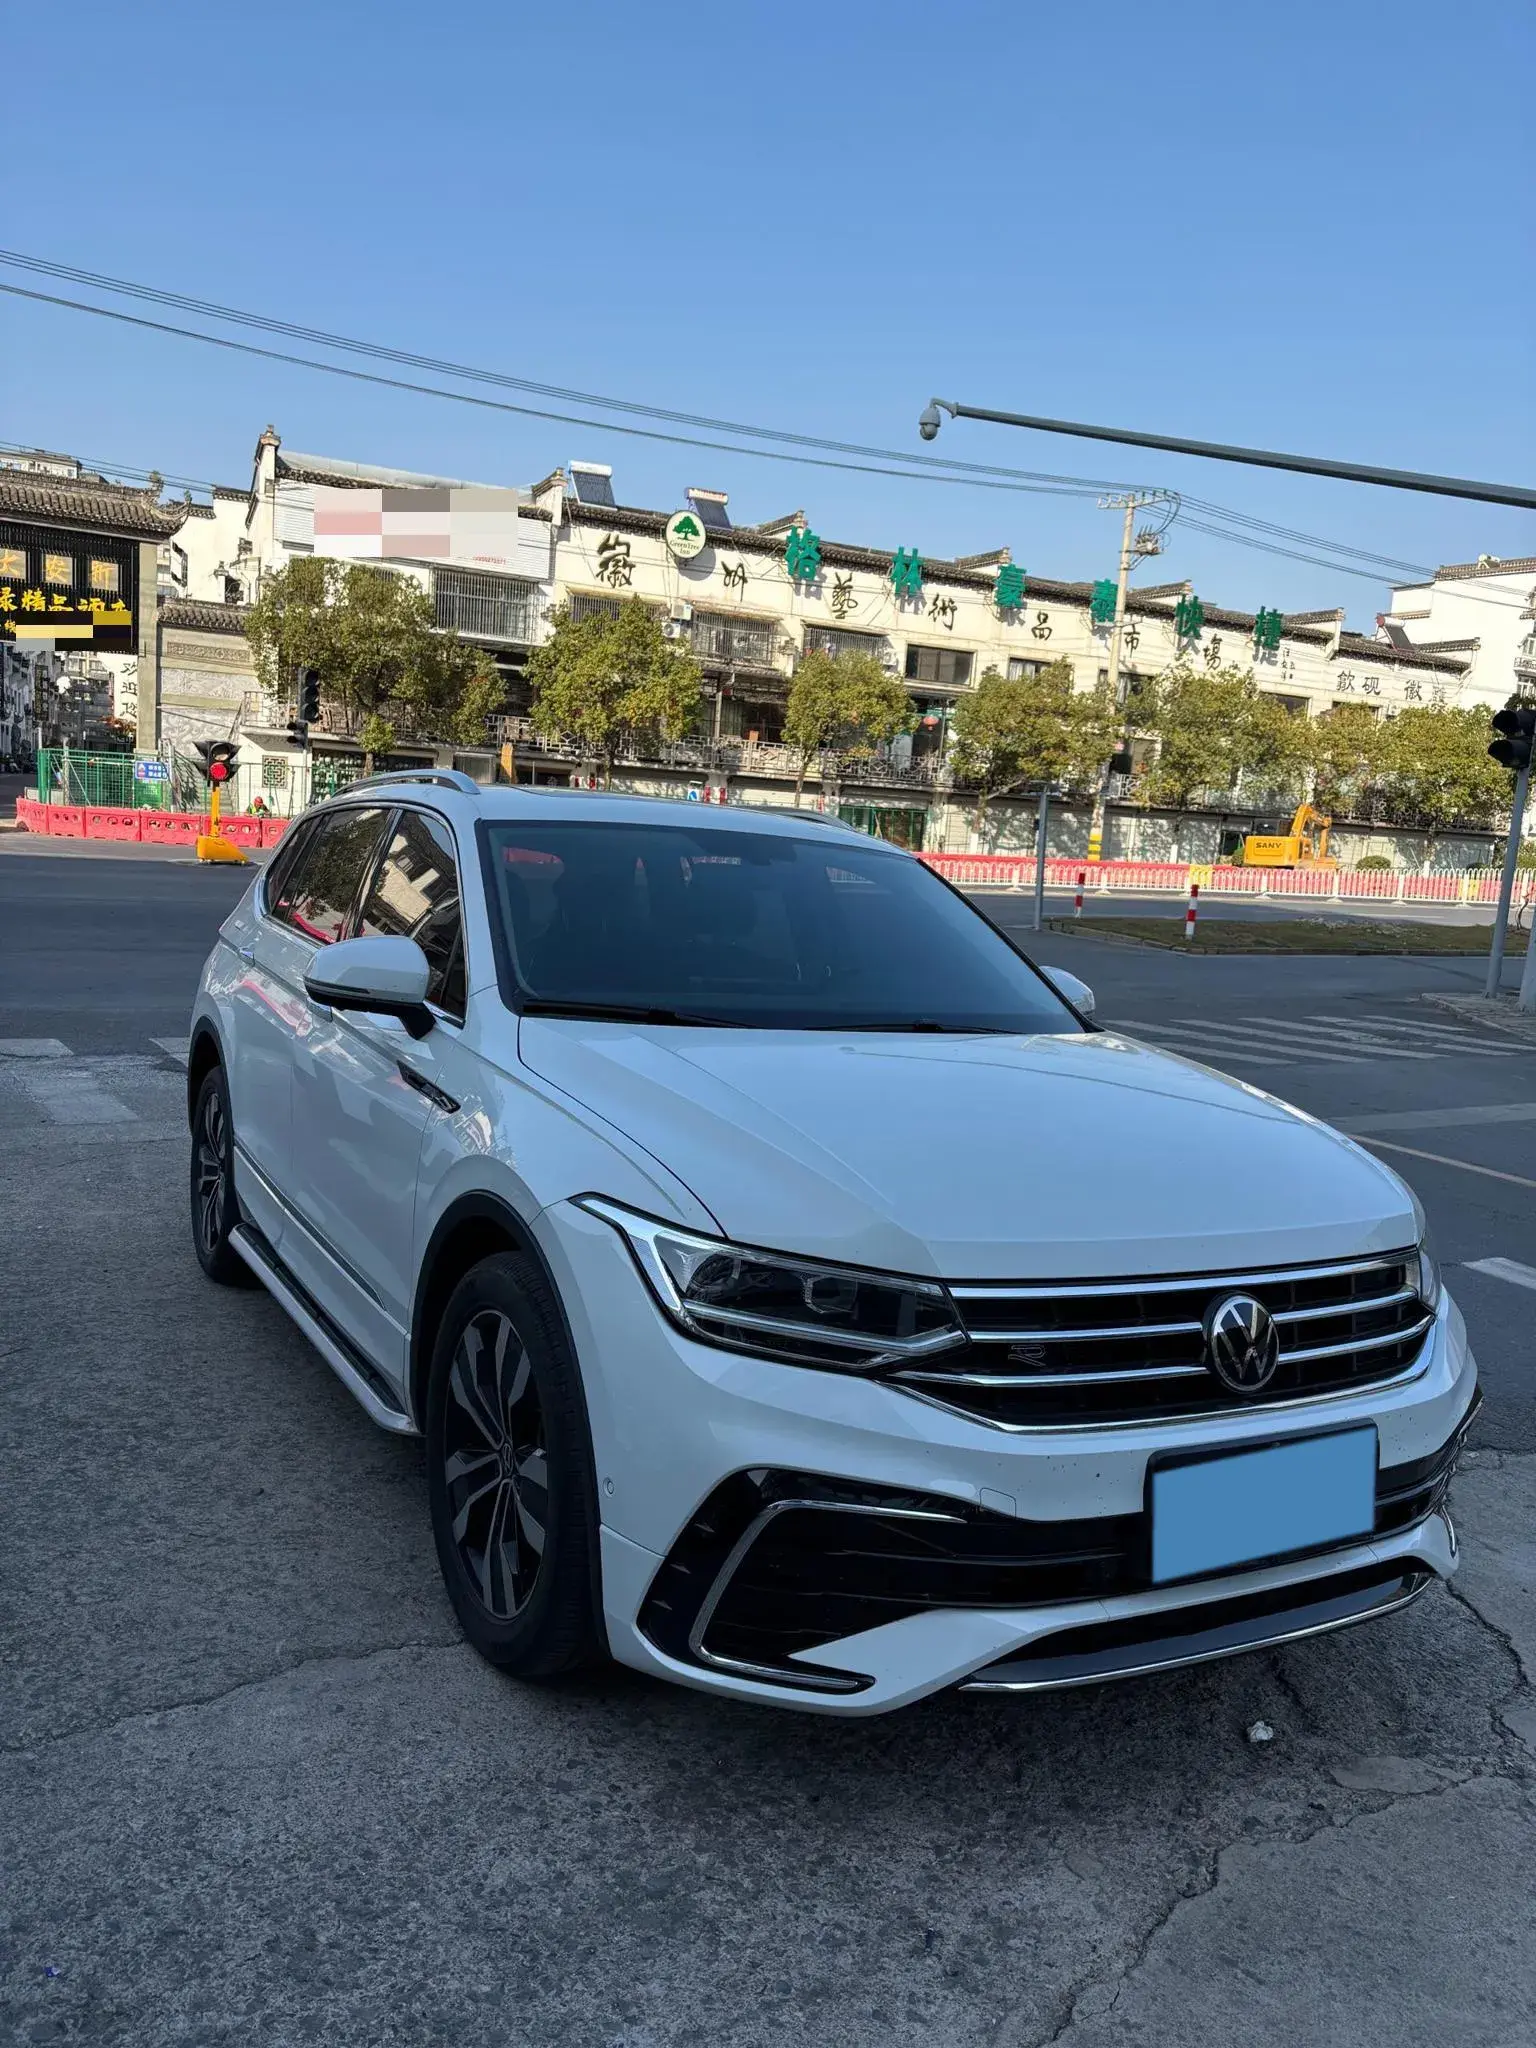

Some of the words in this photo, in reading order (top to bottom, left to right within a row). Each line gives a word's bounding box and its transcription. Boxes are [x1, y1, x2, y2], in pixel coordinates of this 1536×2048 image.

[785, 526, 1283, 651] 格林豪泰快捷
